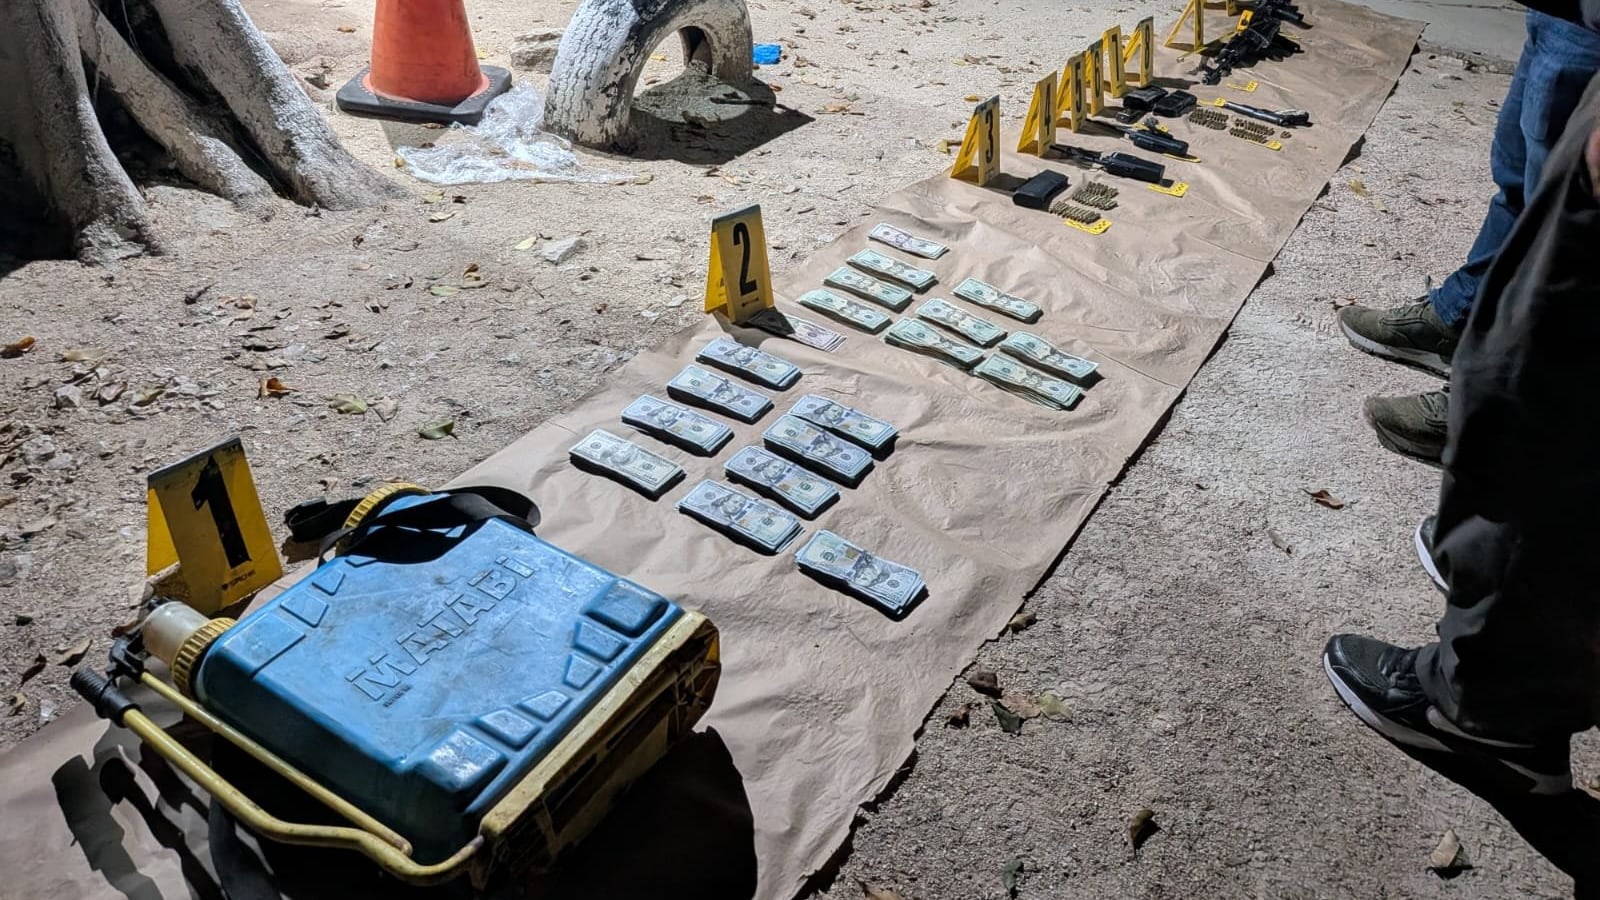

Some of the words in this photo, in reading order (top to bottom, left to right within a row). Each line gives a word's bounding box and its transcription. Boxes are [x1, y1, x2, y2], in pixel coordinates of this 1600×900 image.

[985, 109, 994, 164] 3
[1044, 83, 1051, 137] 4
[733, 222, 758, 297] 2
[191, 455, 253, 570] 1
[344, 555, 536, 702] MATABI
